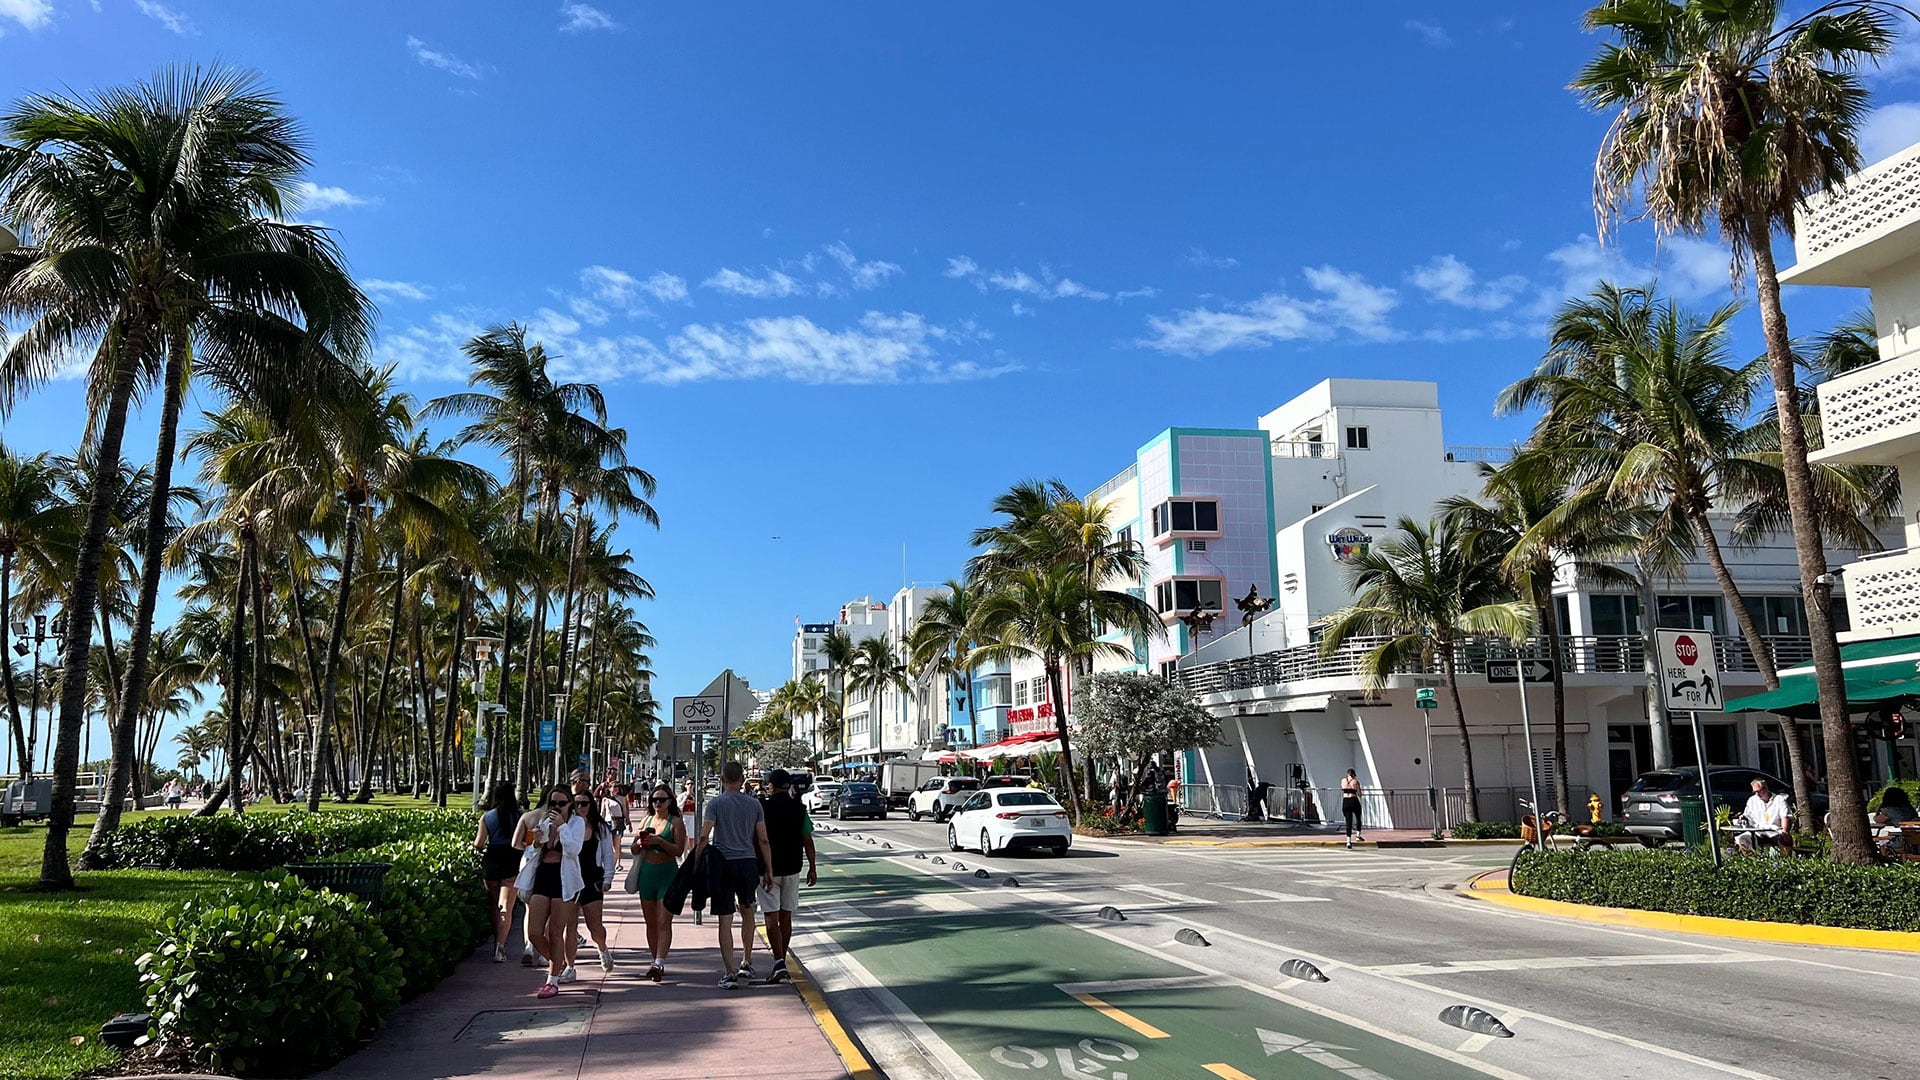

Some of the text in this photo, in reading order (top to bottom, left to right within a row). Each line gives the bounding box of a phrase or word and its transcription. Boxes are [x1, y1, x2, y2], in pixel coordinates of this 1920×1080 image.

[1676, 644, 1697, 657] STOP
[1493, 667, 1512, 676] ONE
[1667, 667, 1688, 679] HERE
[1686, 690, 1702, 702] FOR
